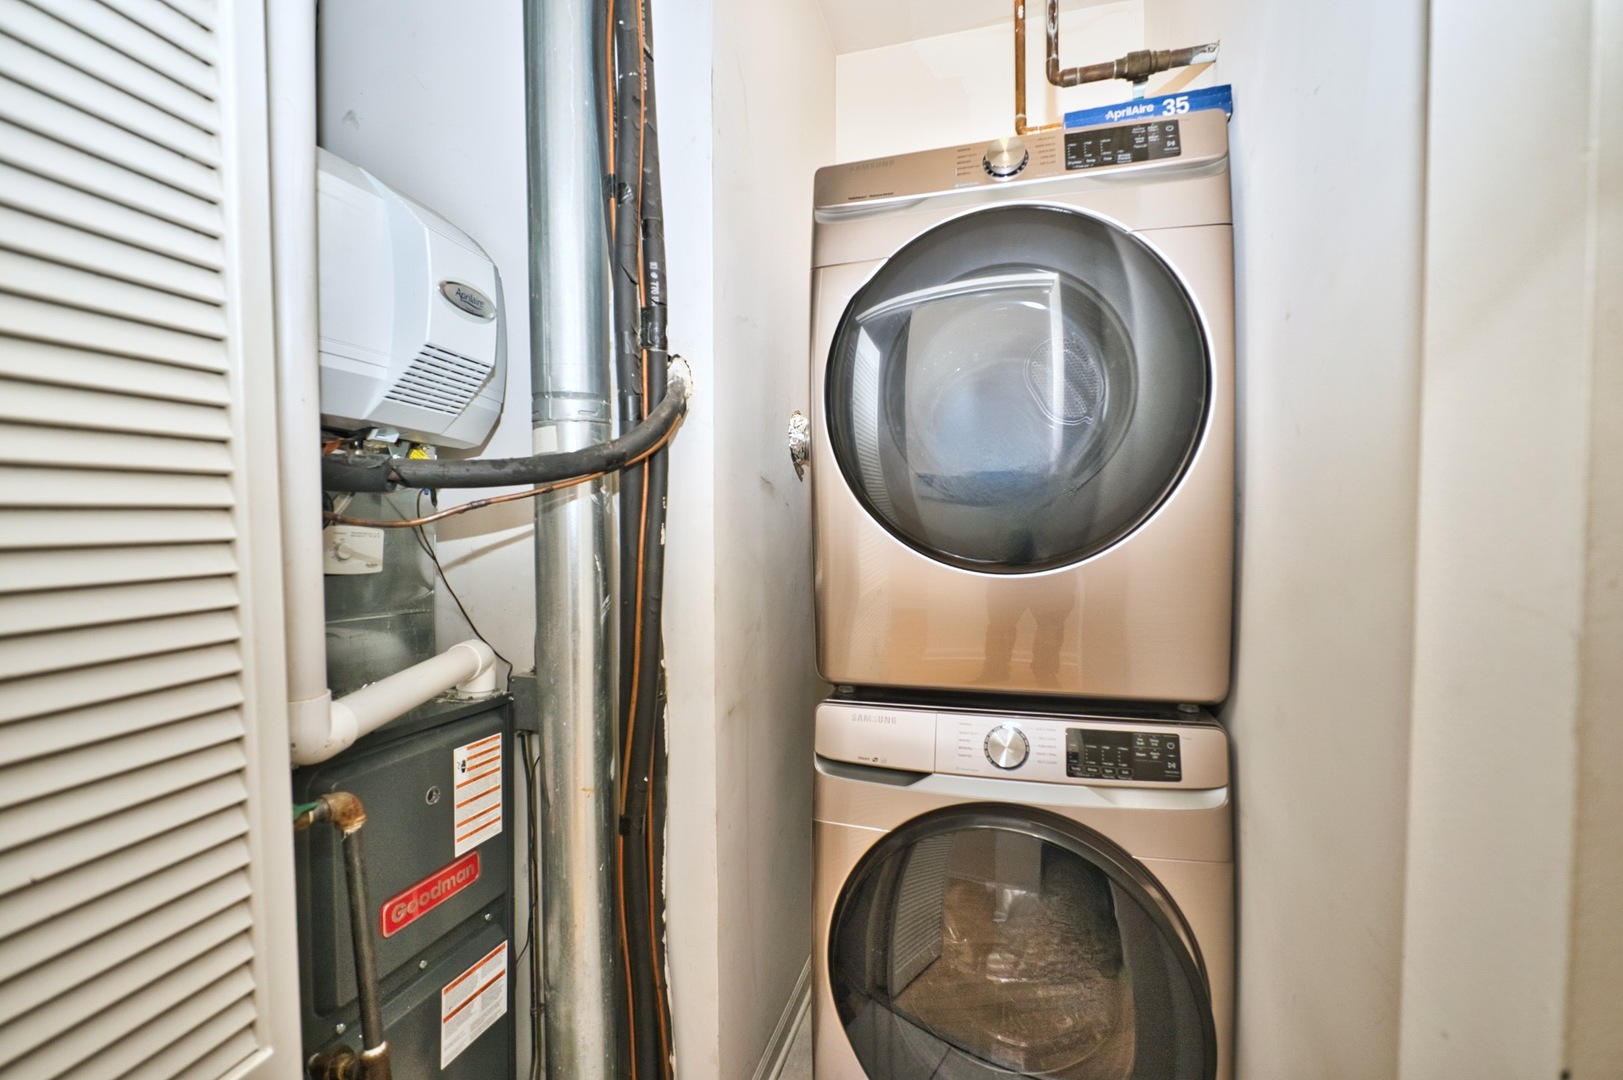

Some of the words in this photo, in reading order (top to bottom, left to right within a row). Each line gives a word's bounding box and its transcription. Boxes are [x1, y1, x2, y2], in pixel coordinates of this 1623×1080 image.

[1105, 104, 1154, 121] AprilAire
[1162, 96, 1190, 116] 35
[852, 713, 897, 725] SAMSUNG
[391, 864, 474, 923] Goodman
